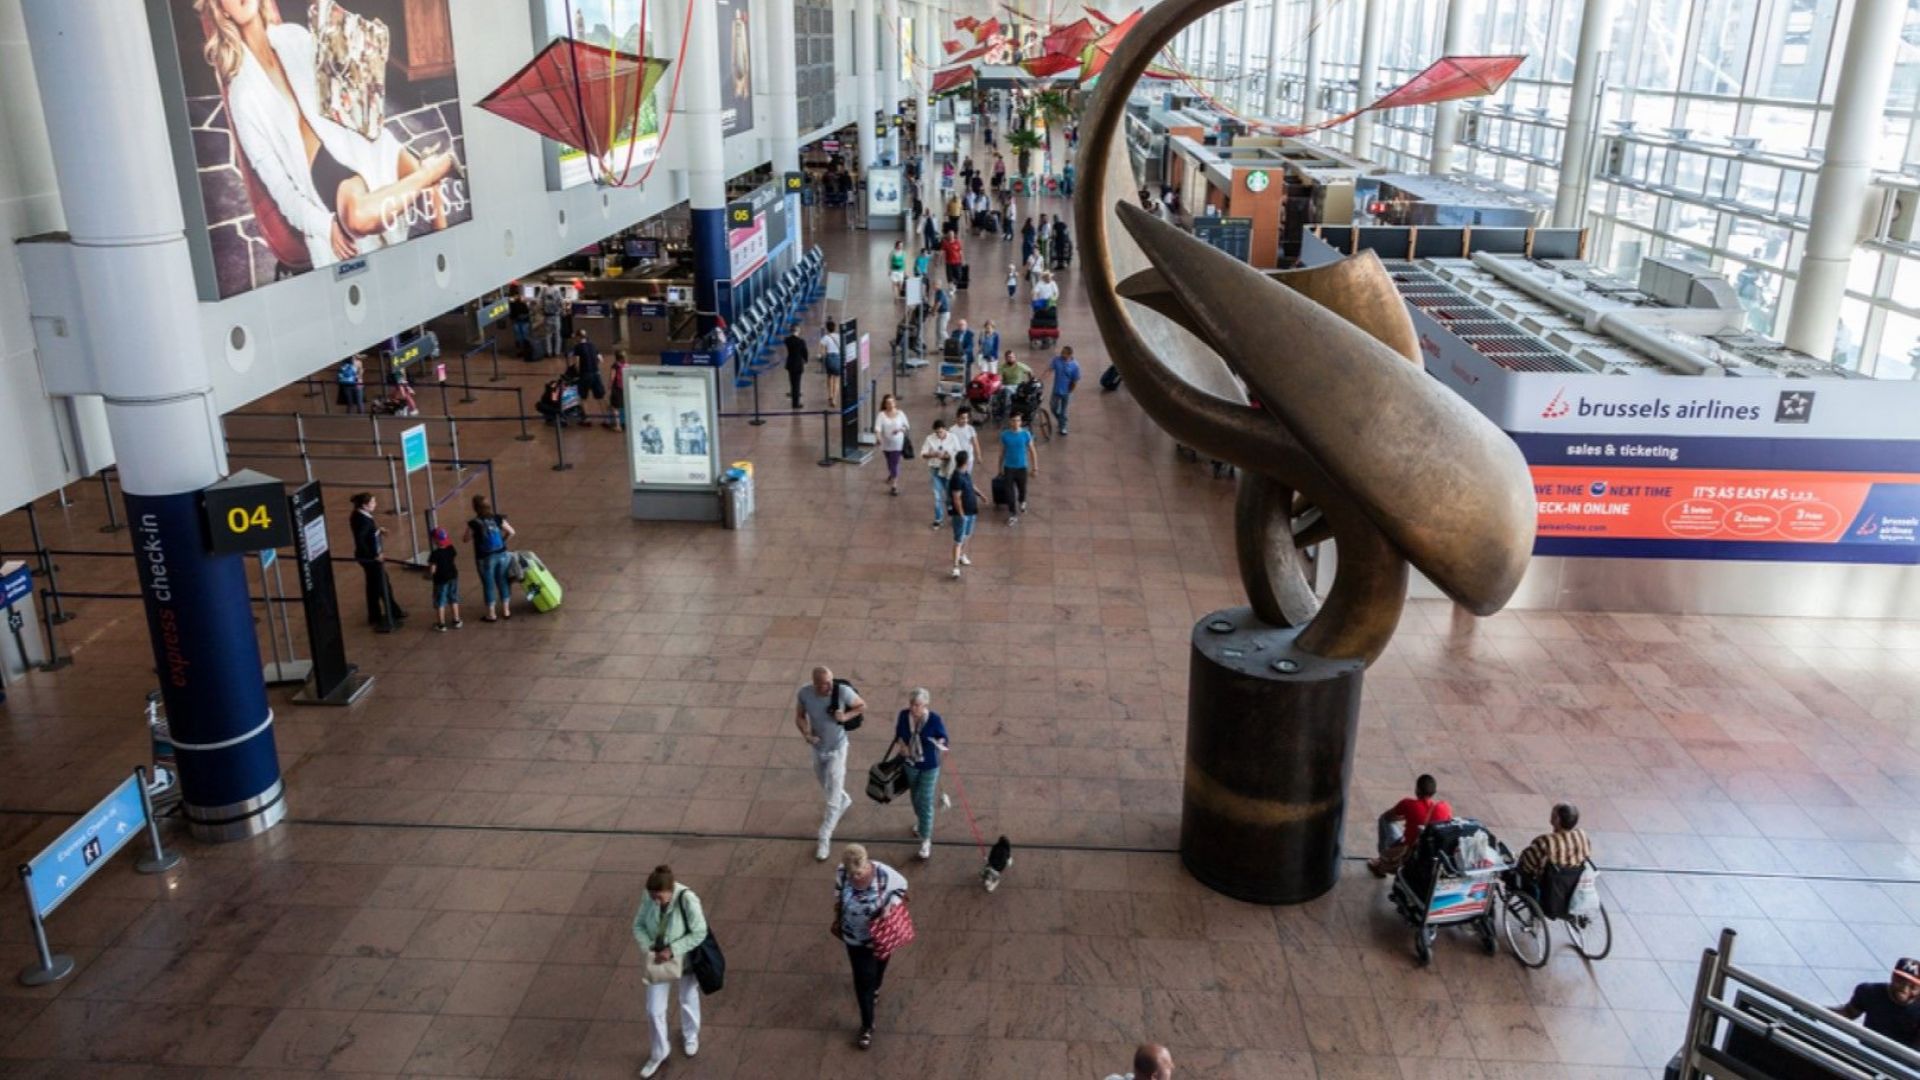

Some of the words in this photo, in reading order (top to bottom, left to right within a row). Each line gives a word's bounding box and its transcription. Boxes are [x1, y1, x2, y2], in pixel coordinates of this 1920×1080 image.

[380, 178, 466, 231] GUESS
[734, 210, 748, 221] 05
[1577, 396, 1670, 419] brussels
[1676, 400, 1760, 421] airlines
[1566, 444, 1602, 456] sales
[1604, 444, 1615, 457] &
[1620, 444, 1679, 460] ticketing
[1535, 484, 1552, 495] AVE
[1557, 484, 1584, 495] TIME
[1609, 486, 1641, 497] NEXT
[1644, 486, 1673, 497] TIME
[1718, 487, 1735, 500] AS
[1736, 487, 1770, 500] EASY
[1771, 487, 1788, 500] AS
[1583, 503, 1631, 515] ONLINE
[227, 504, 273, 533] 04
[139, 514, 171, 601] check-in
[159, 609, 190, 686] express
